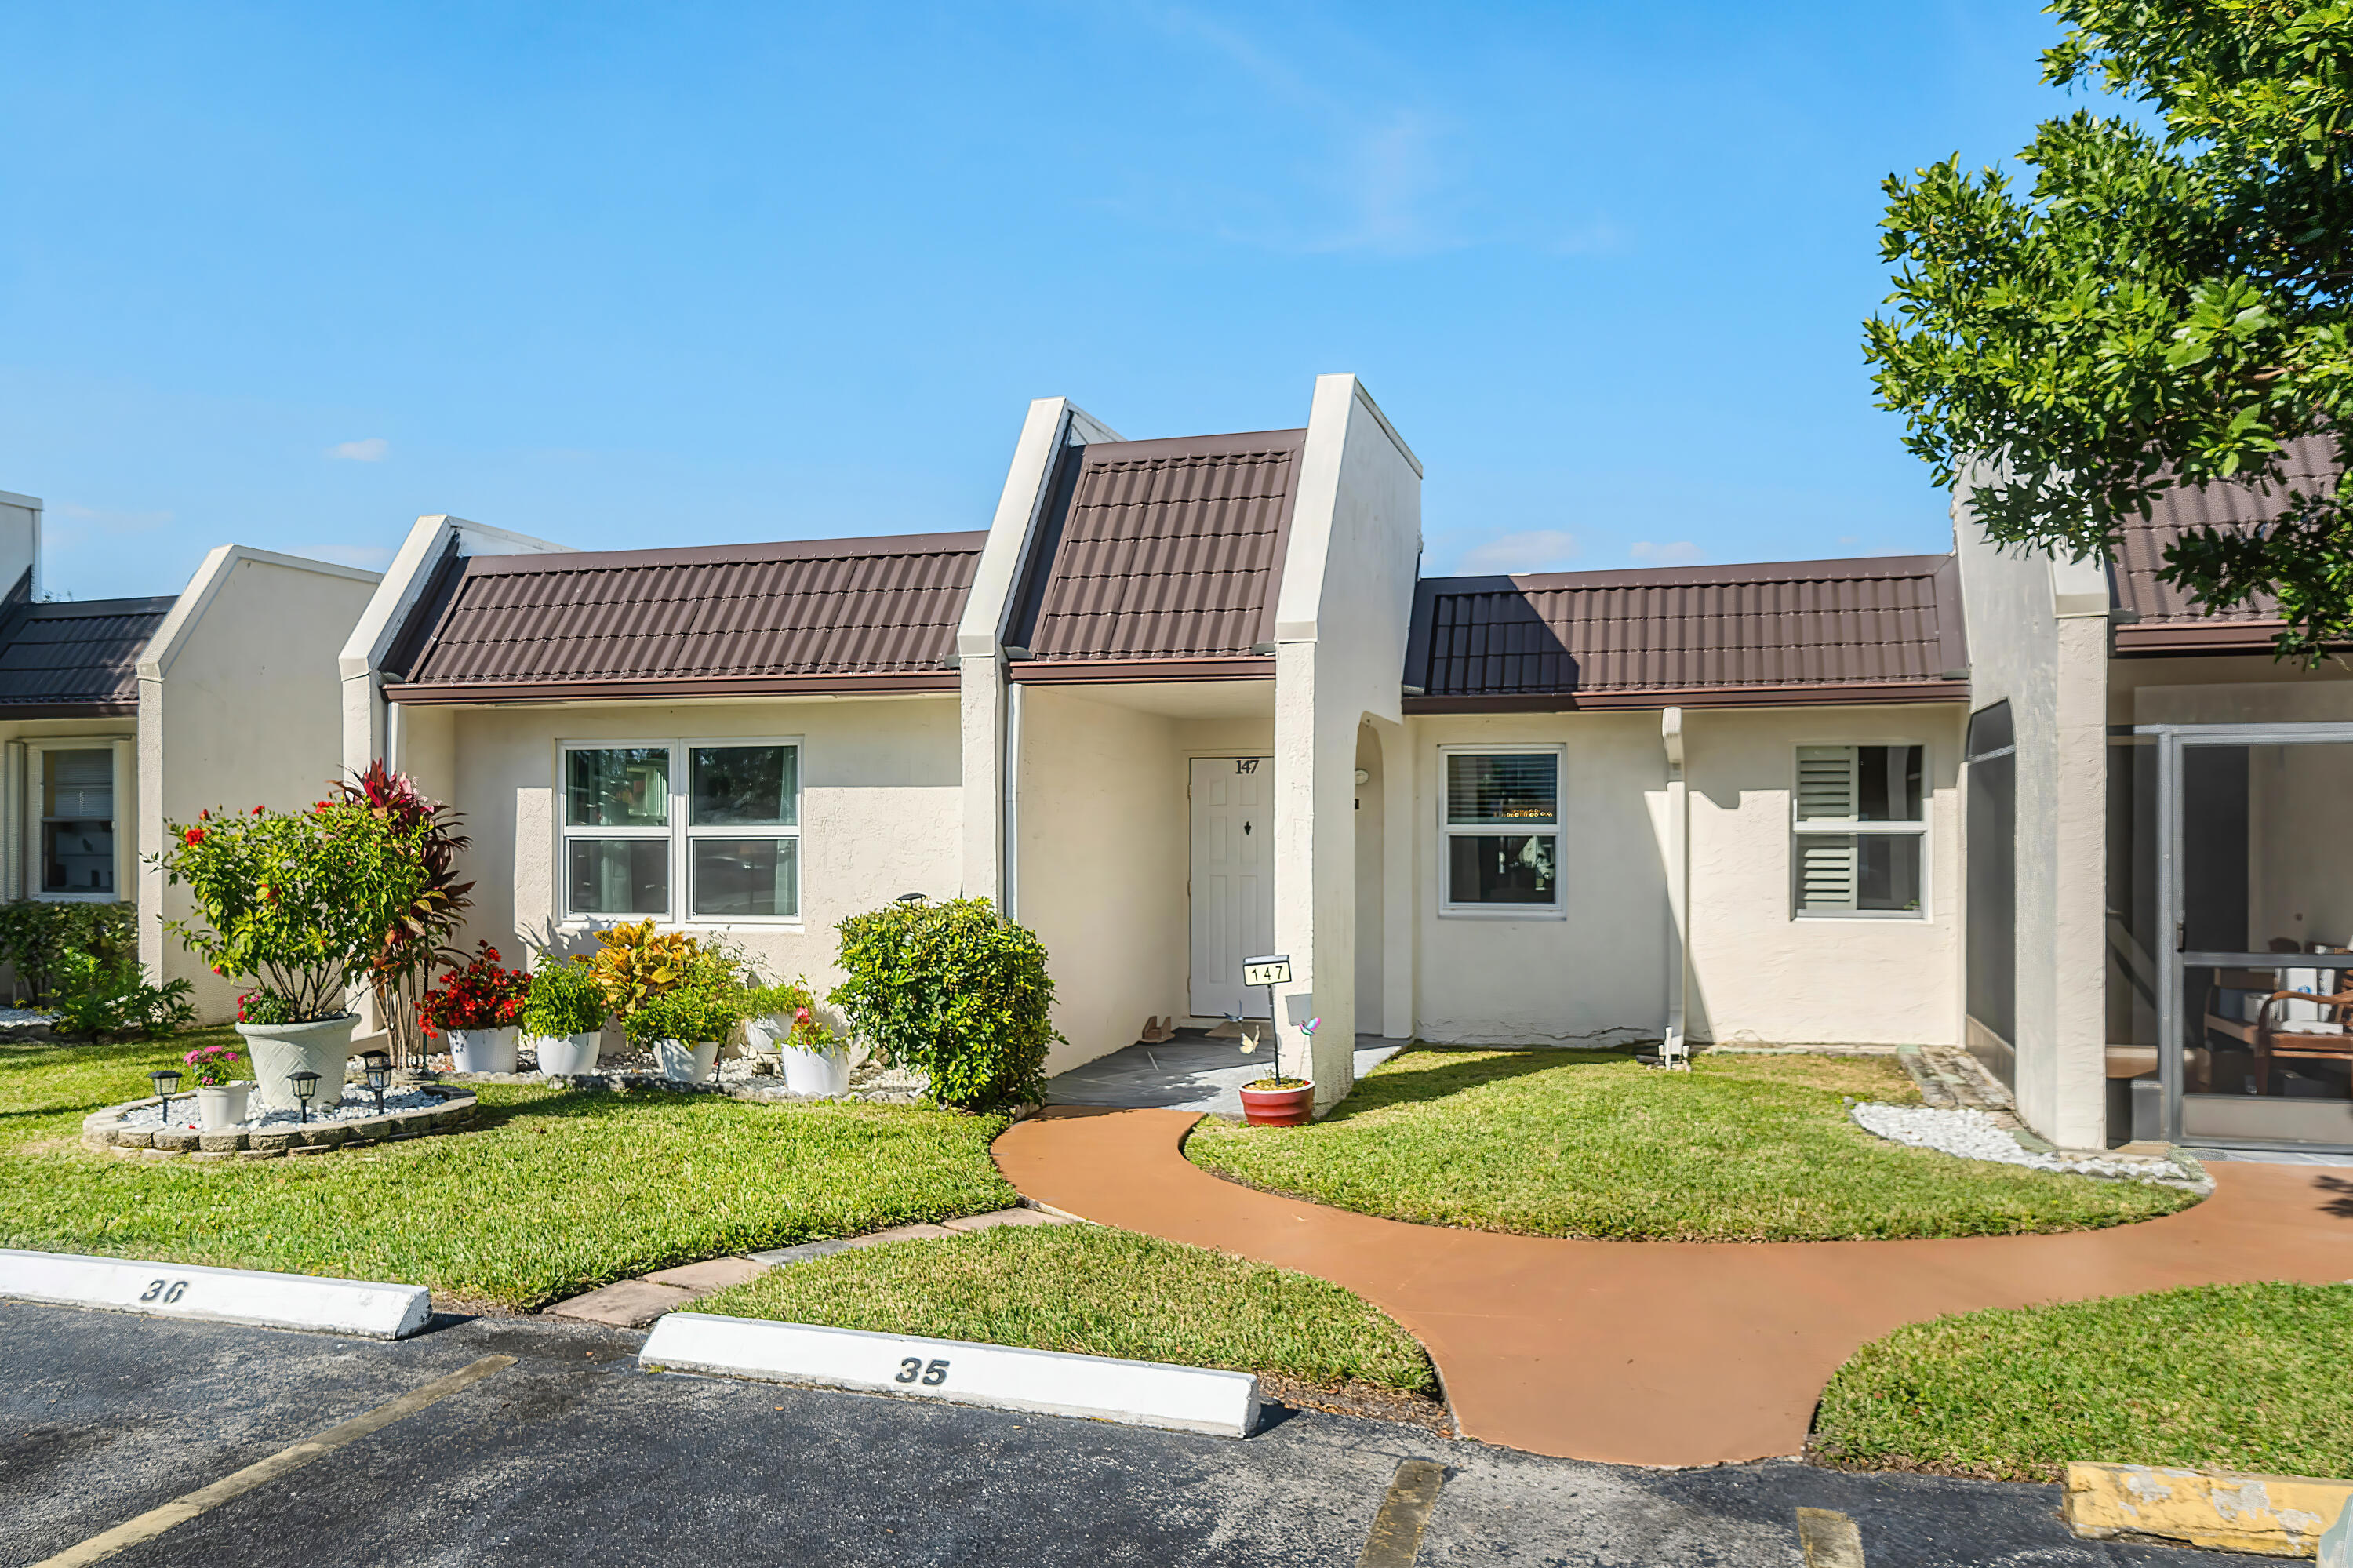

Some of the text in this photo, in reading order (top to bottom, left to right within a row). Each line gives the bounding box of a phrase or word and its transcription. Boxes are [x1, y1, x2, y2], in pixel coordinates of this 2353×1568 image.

[1235, 759, 1260, 774] 147
[1252, 966, 1283, 981] 147
[140, 1279, 189, 1304] 36
[896, 1357, 950, 1385] 35
